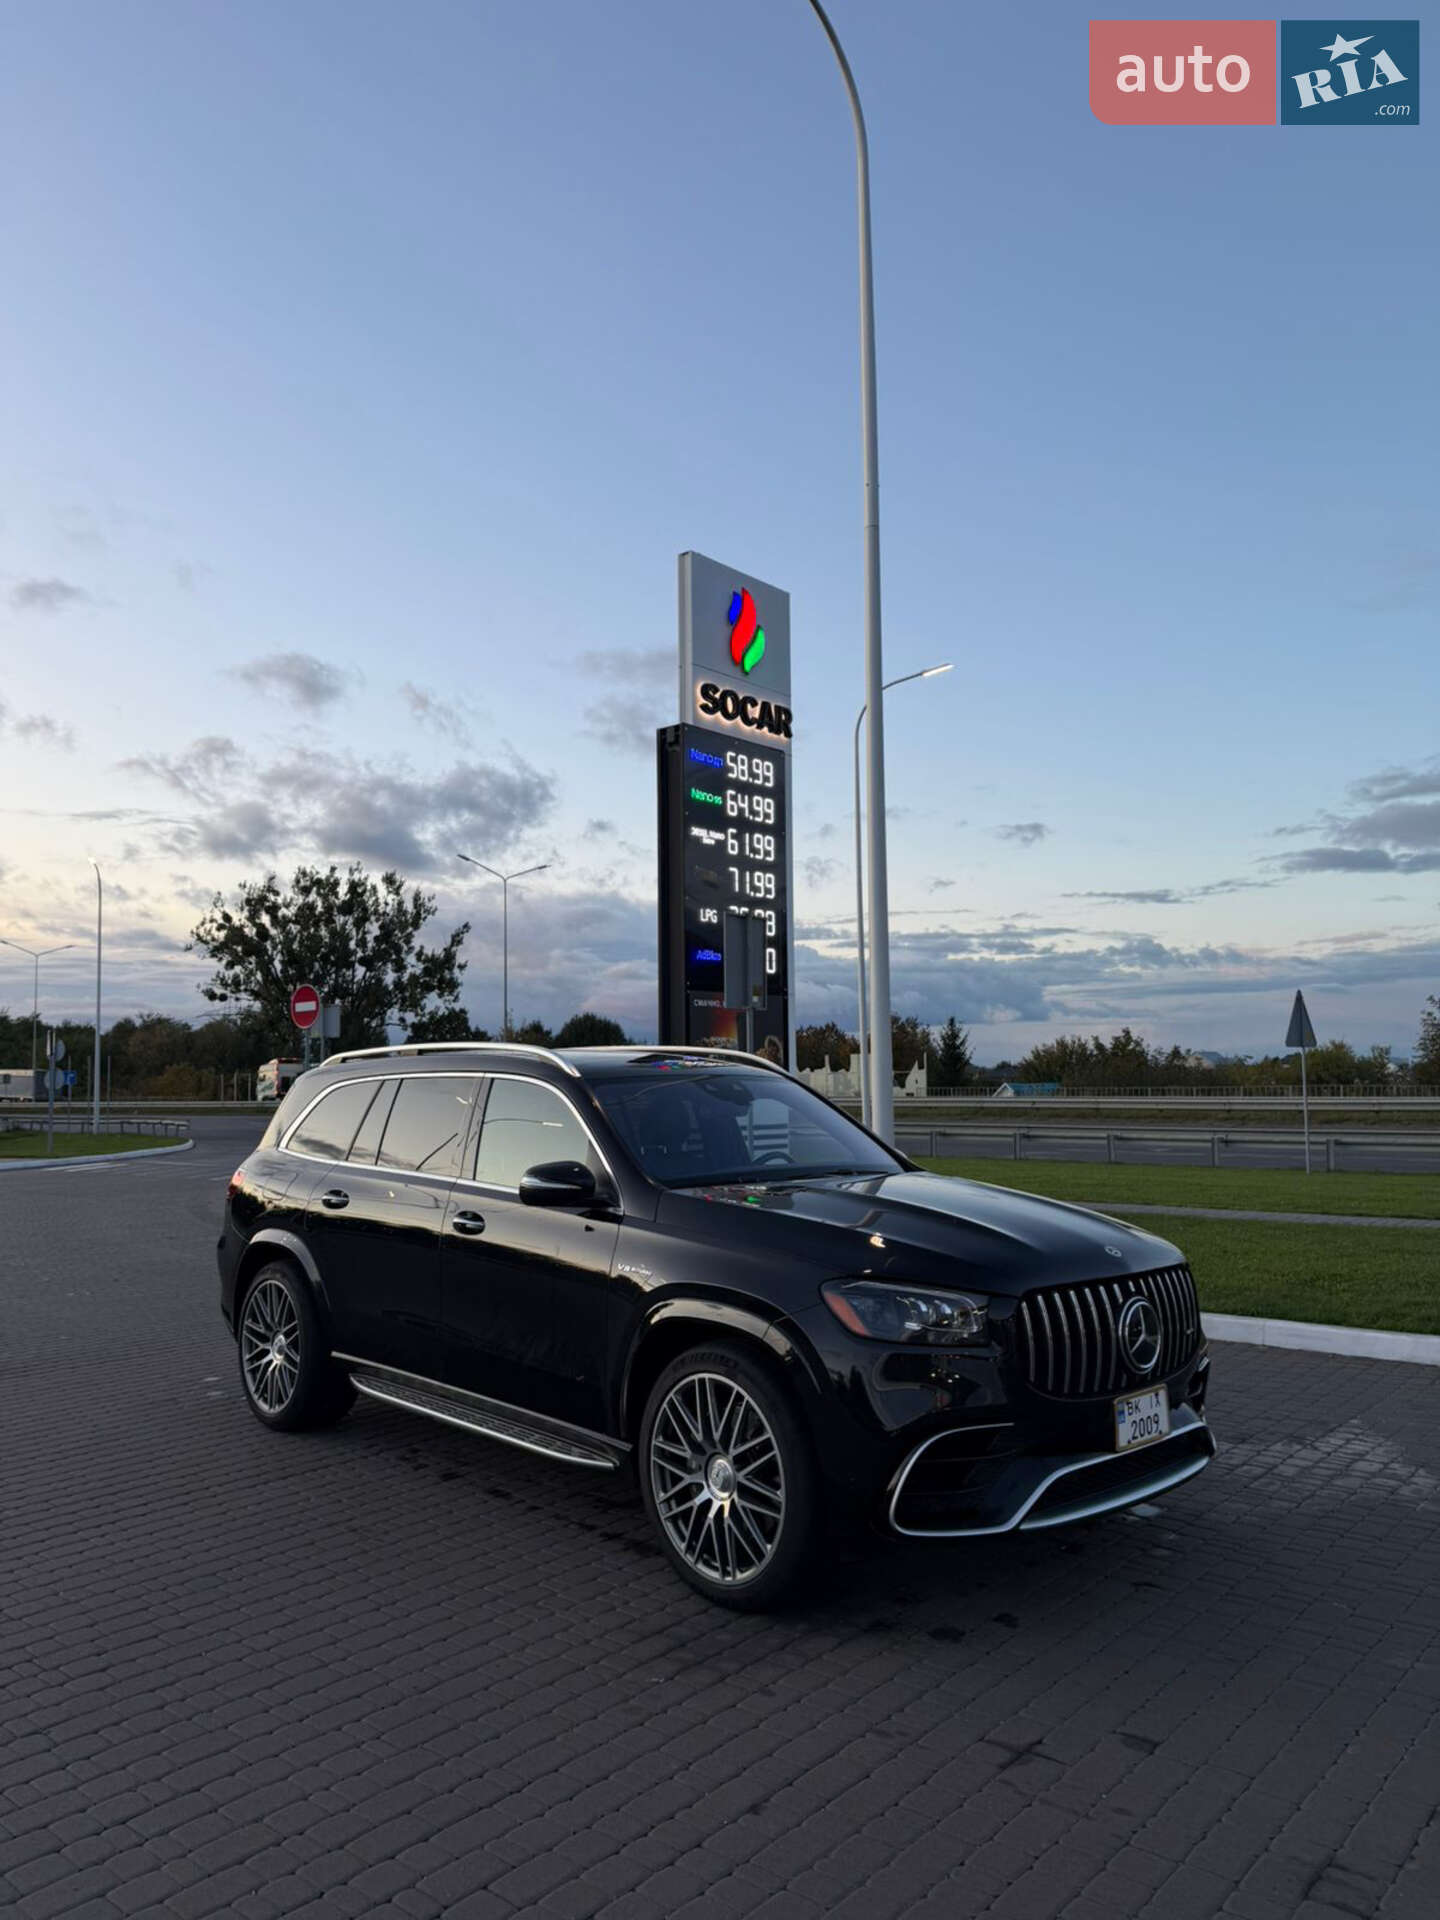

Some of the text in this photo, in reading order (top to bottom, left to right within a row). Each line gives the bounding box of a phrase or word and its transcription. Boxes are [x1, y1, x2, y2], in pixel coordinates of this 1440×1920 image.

[699, 682, 793, 739] SOCAR
[726, 751, 775, 788] 58.99
[726, 789, 775, 825] 64.99
[727, 828, 775, 862] 61.99
[728, 866, 776, 899] 71.99
[700, 908, 718, 924] LPG
[1131, 1413, 1160, 1441] 2009
